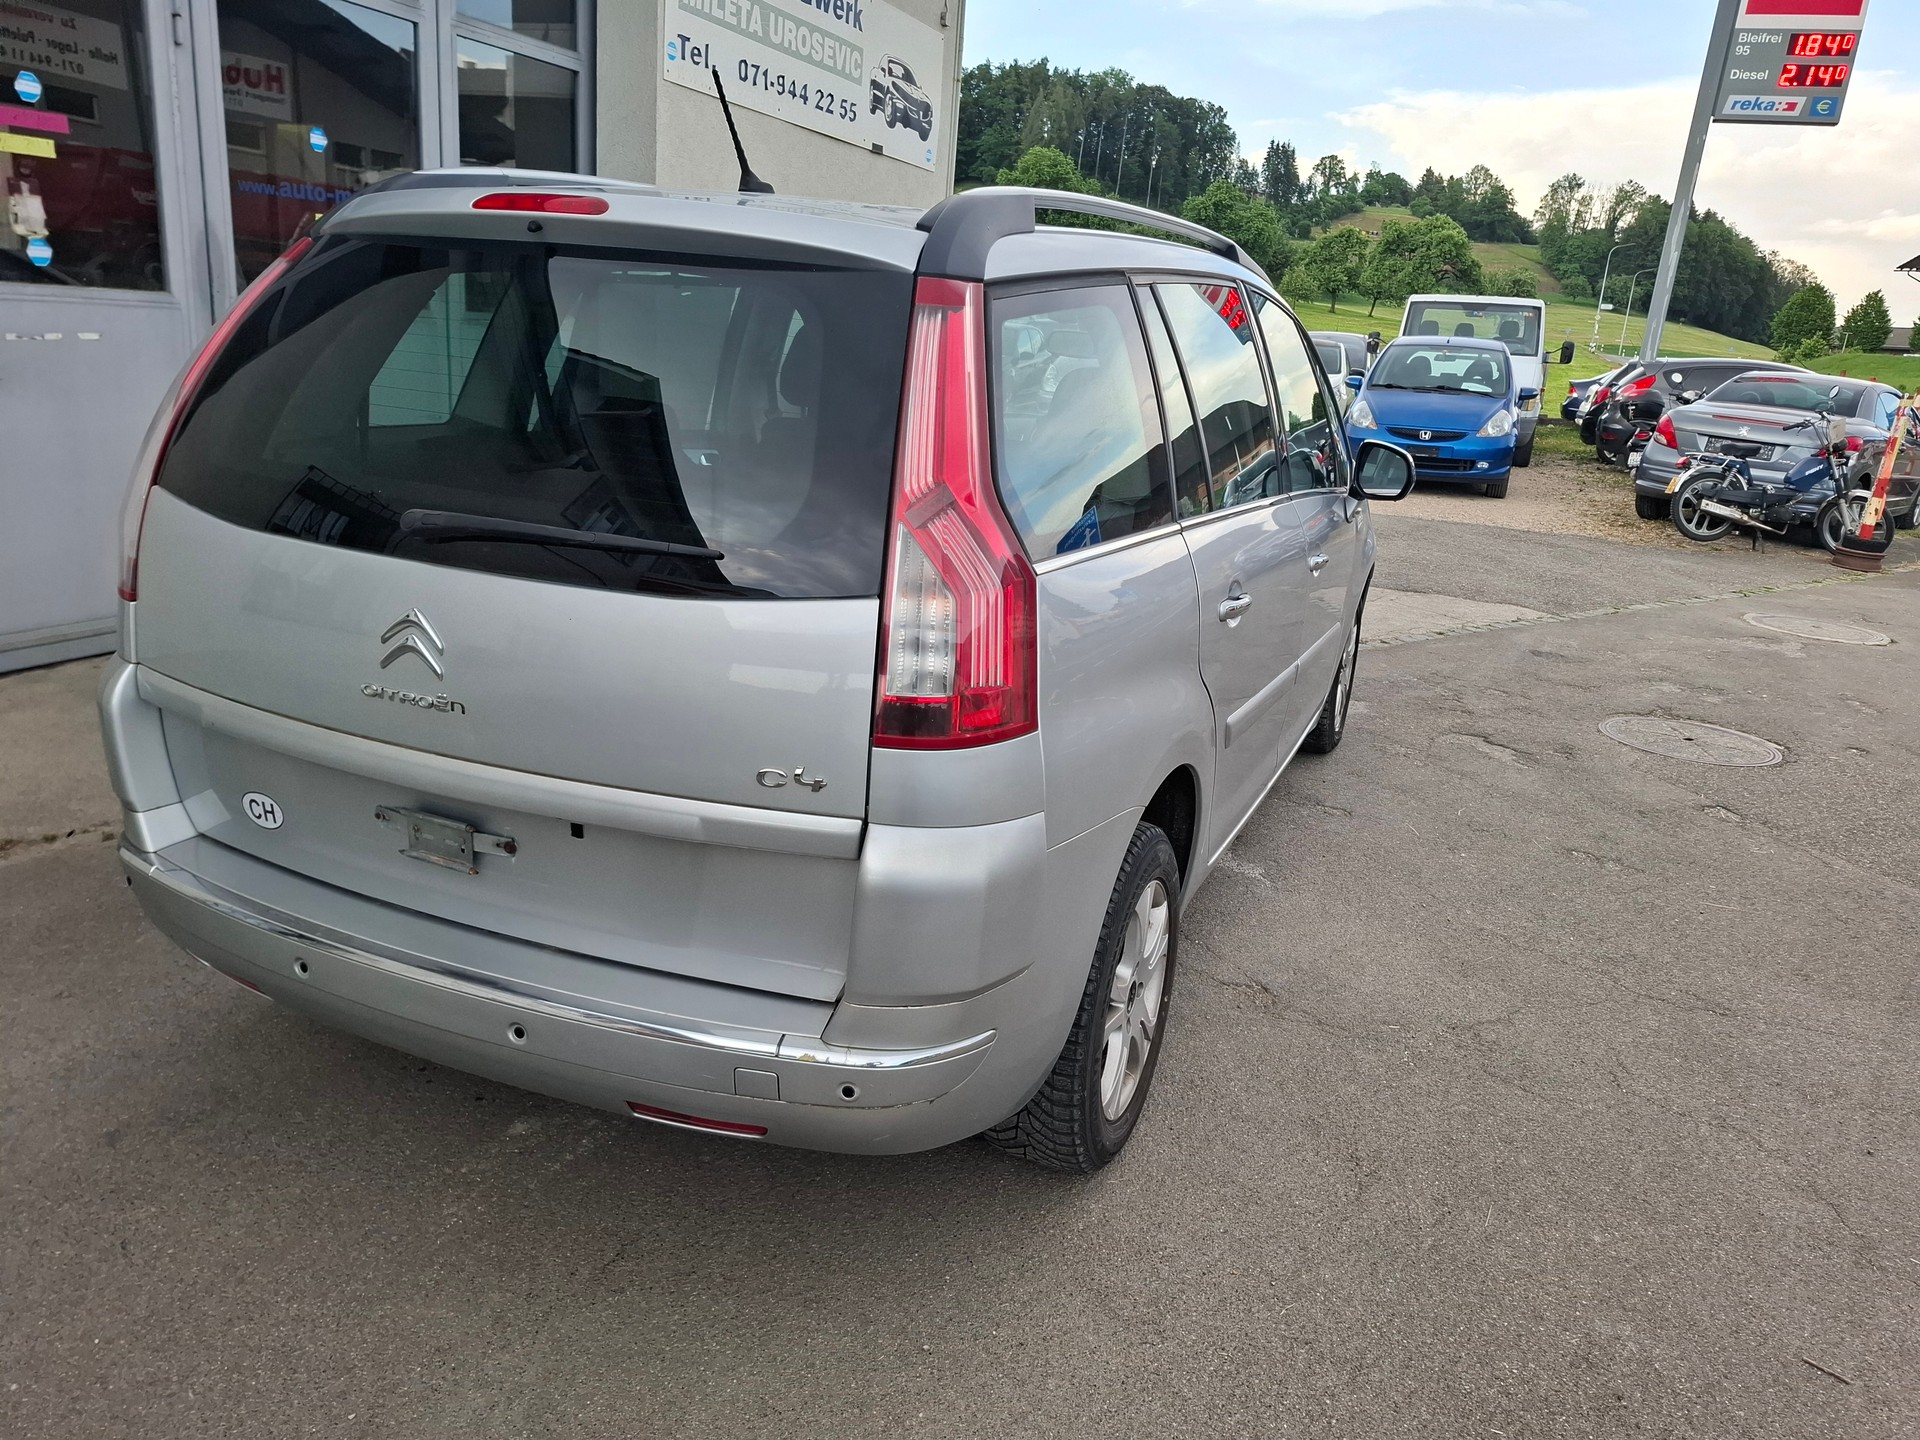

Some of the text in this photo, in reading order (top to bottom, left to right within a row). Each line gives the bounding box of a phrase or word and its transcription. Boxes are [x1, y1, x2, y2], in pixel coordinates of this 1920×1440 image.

[769, 11, 862, 79] UROSEVIC
[1738, 32, 1783, 43] Bleifrei
[1735, 45, 1751, 56] 95
[1730, 69, 1768, 80] Diesel
[738, 59, 809, 106] 071-944
[815, 89, 835, 115] 22
[839, 98, 857, 123] 55
[249, 799, 277, 824] CH
